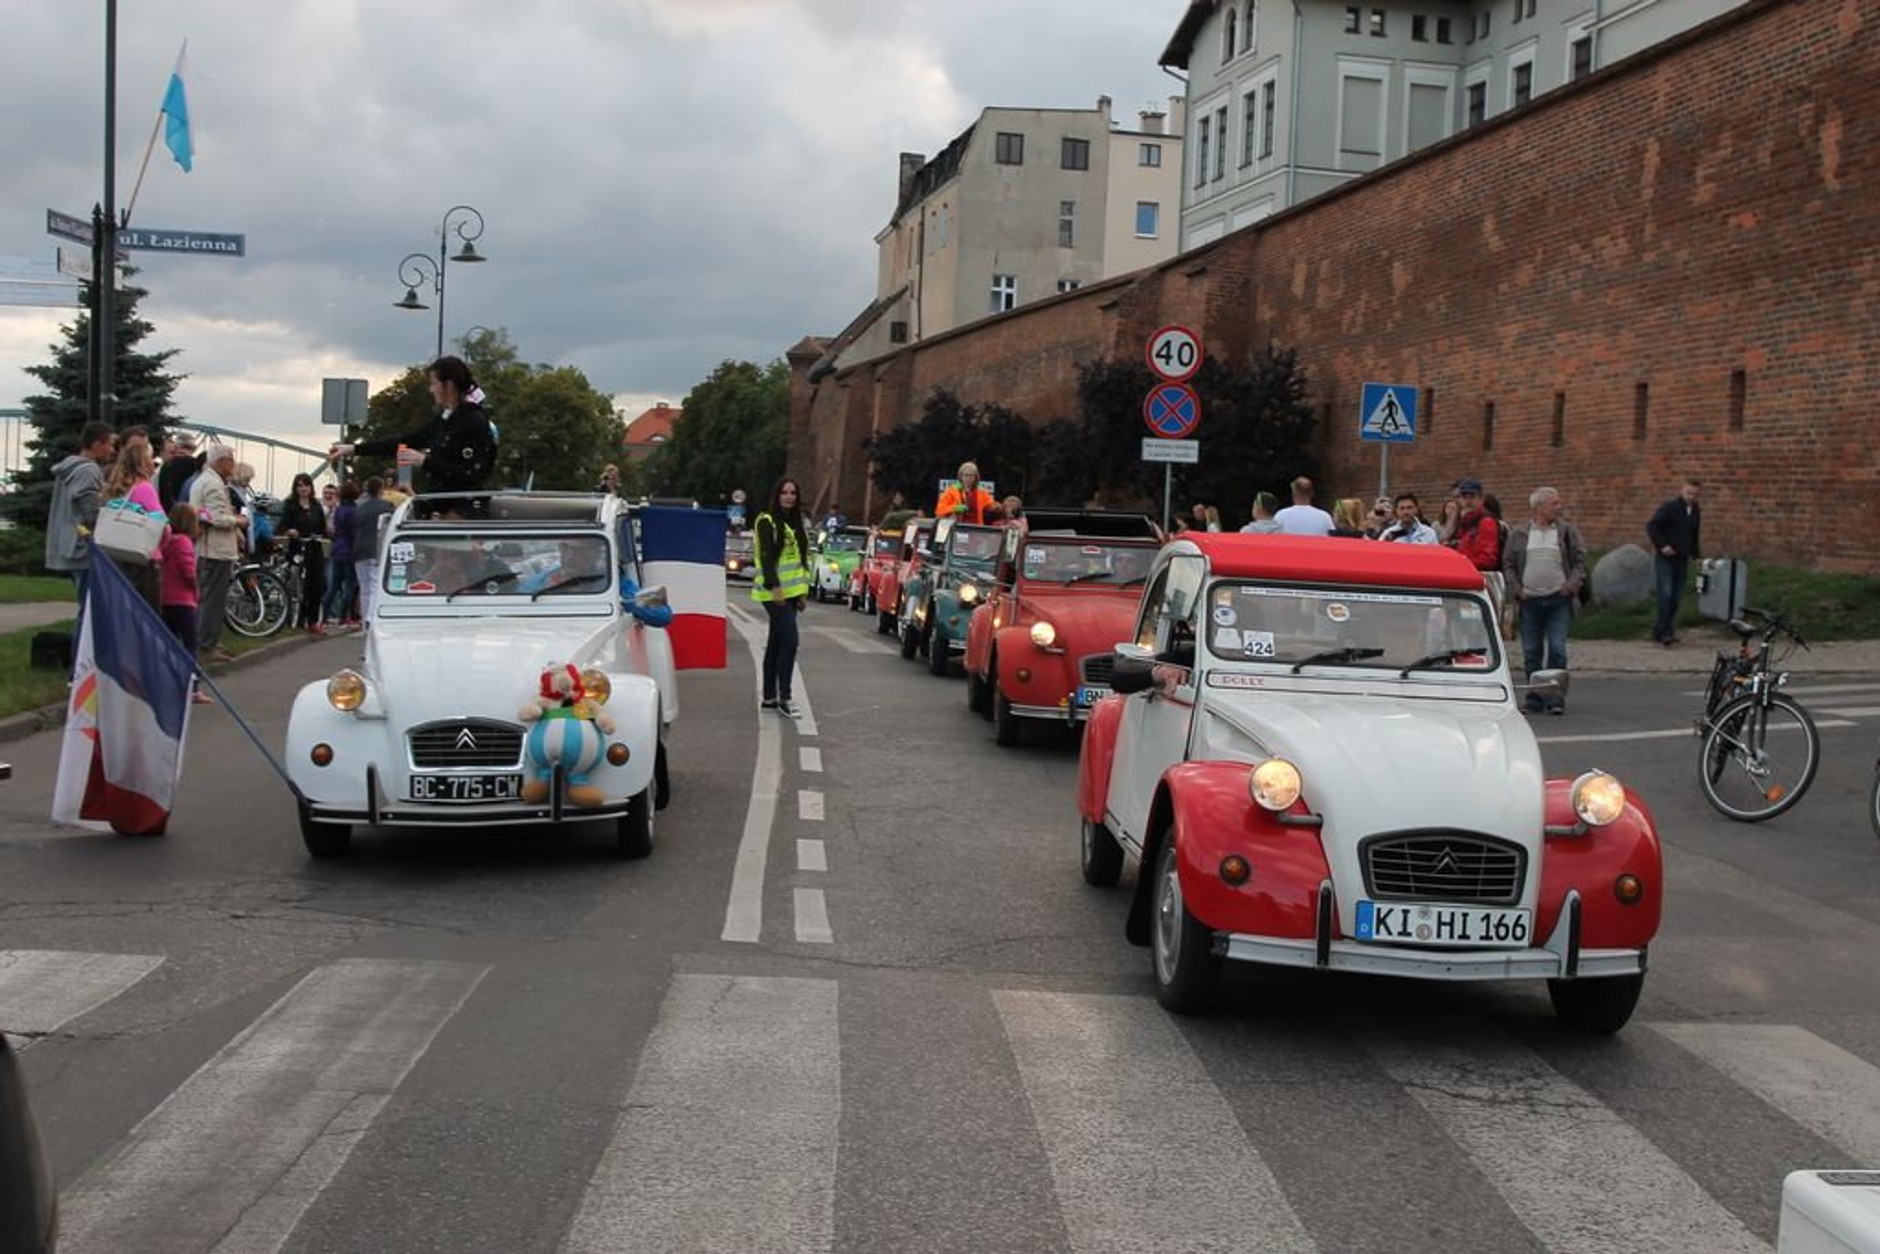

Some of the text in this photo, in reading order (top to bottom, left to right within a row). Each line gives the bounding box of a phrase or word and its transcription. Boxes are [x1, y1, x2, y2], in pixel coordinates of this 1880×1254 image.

[119, 233, 237, 251] ul. Łazienna
[1155, 339, 1195, 367] 40
[1244, 641, 1273, 655] 424
[1374, 907, 1527, 942] KI HI 166
